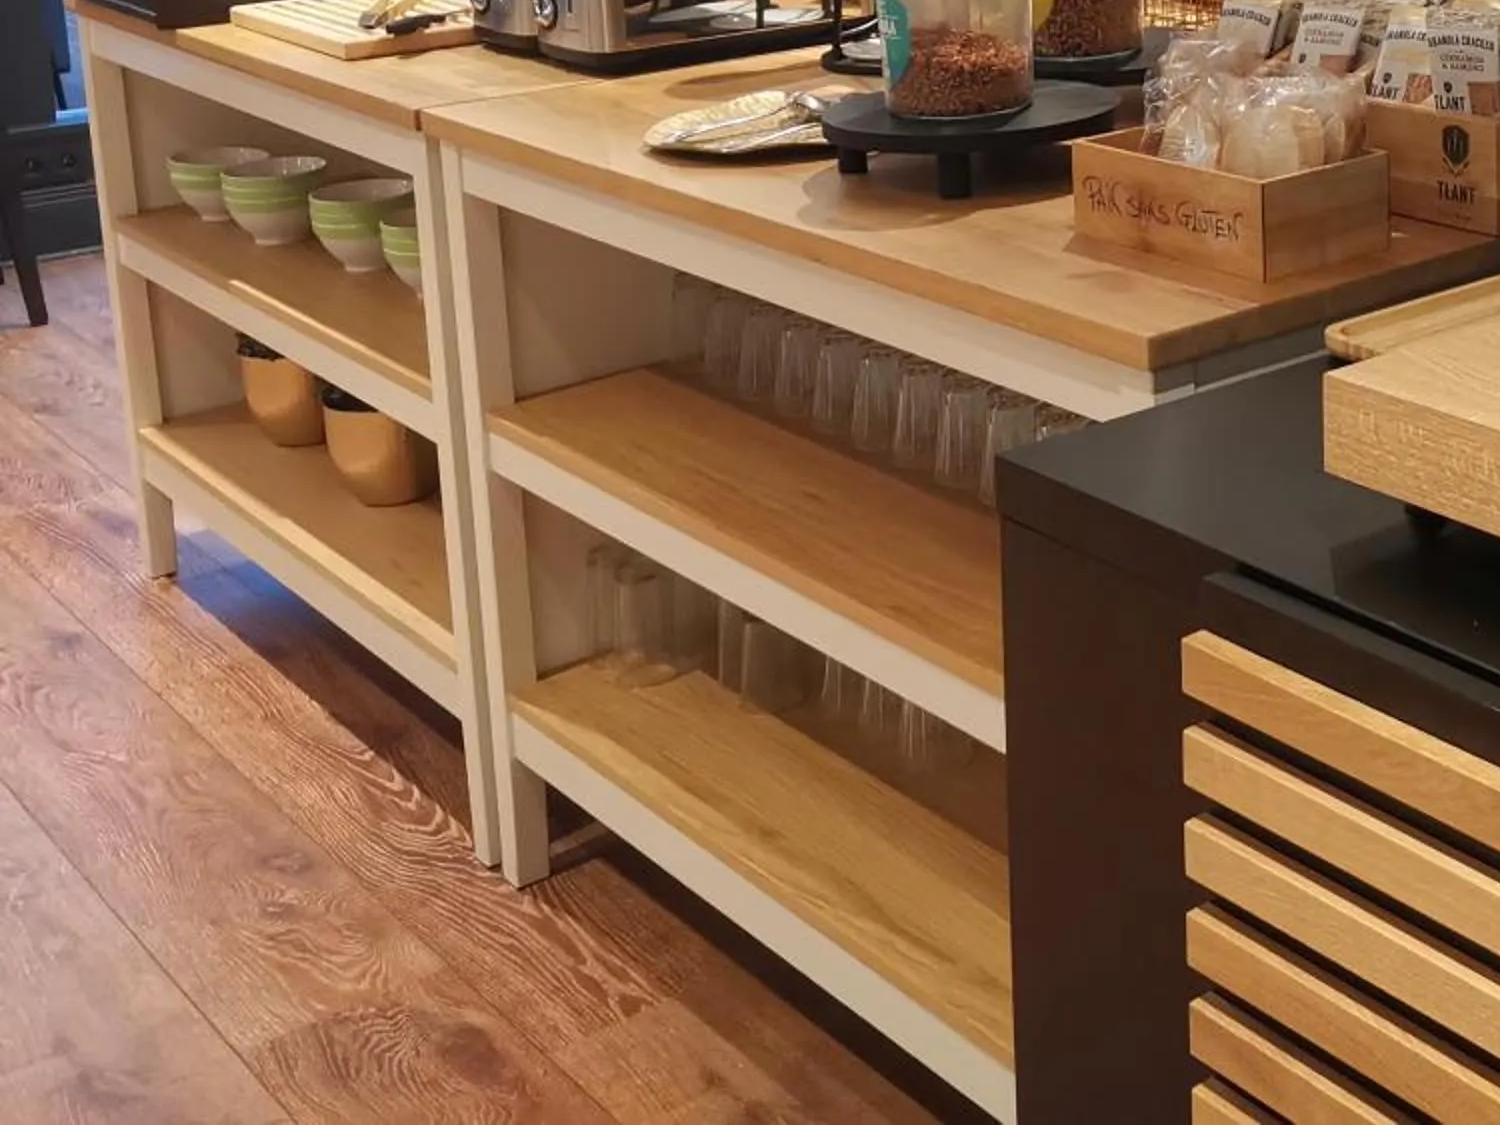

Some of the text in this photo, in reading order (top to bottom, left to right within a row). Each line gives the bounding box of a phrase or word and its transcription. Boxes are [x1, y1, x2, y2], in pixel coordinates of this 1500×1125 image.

[1434, 94, 1465, 112] TLANT
[1437, 179, 1477, 204] TLANT
[1175, 201, 1244, 241] GLUTEN
